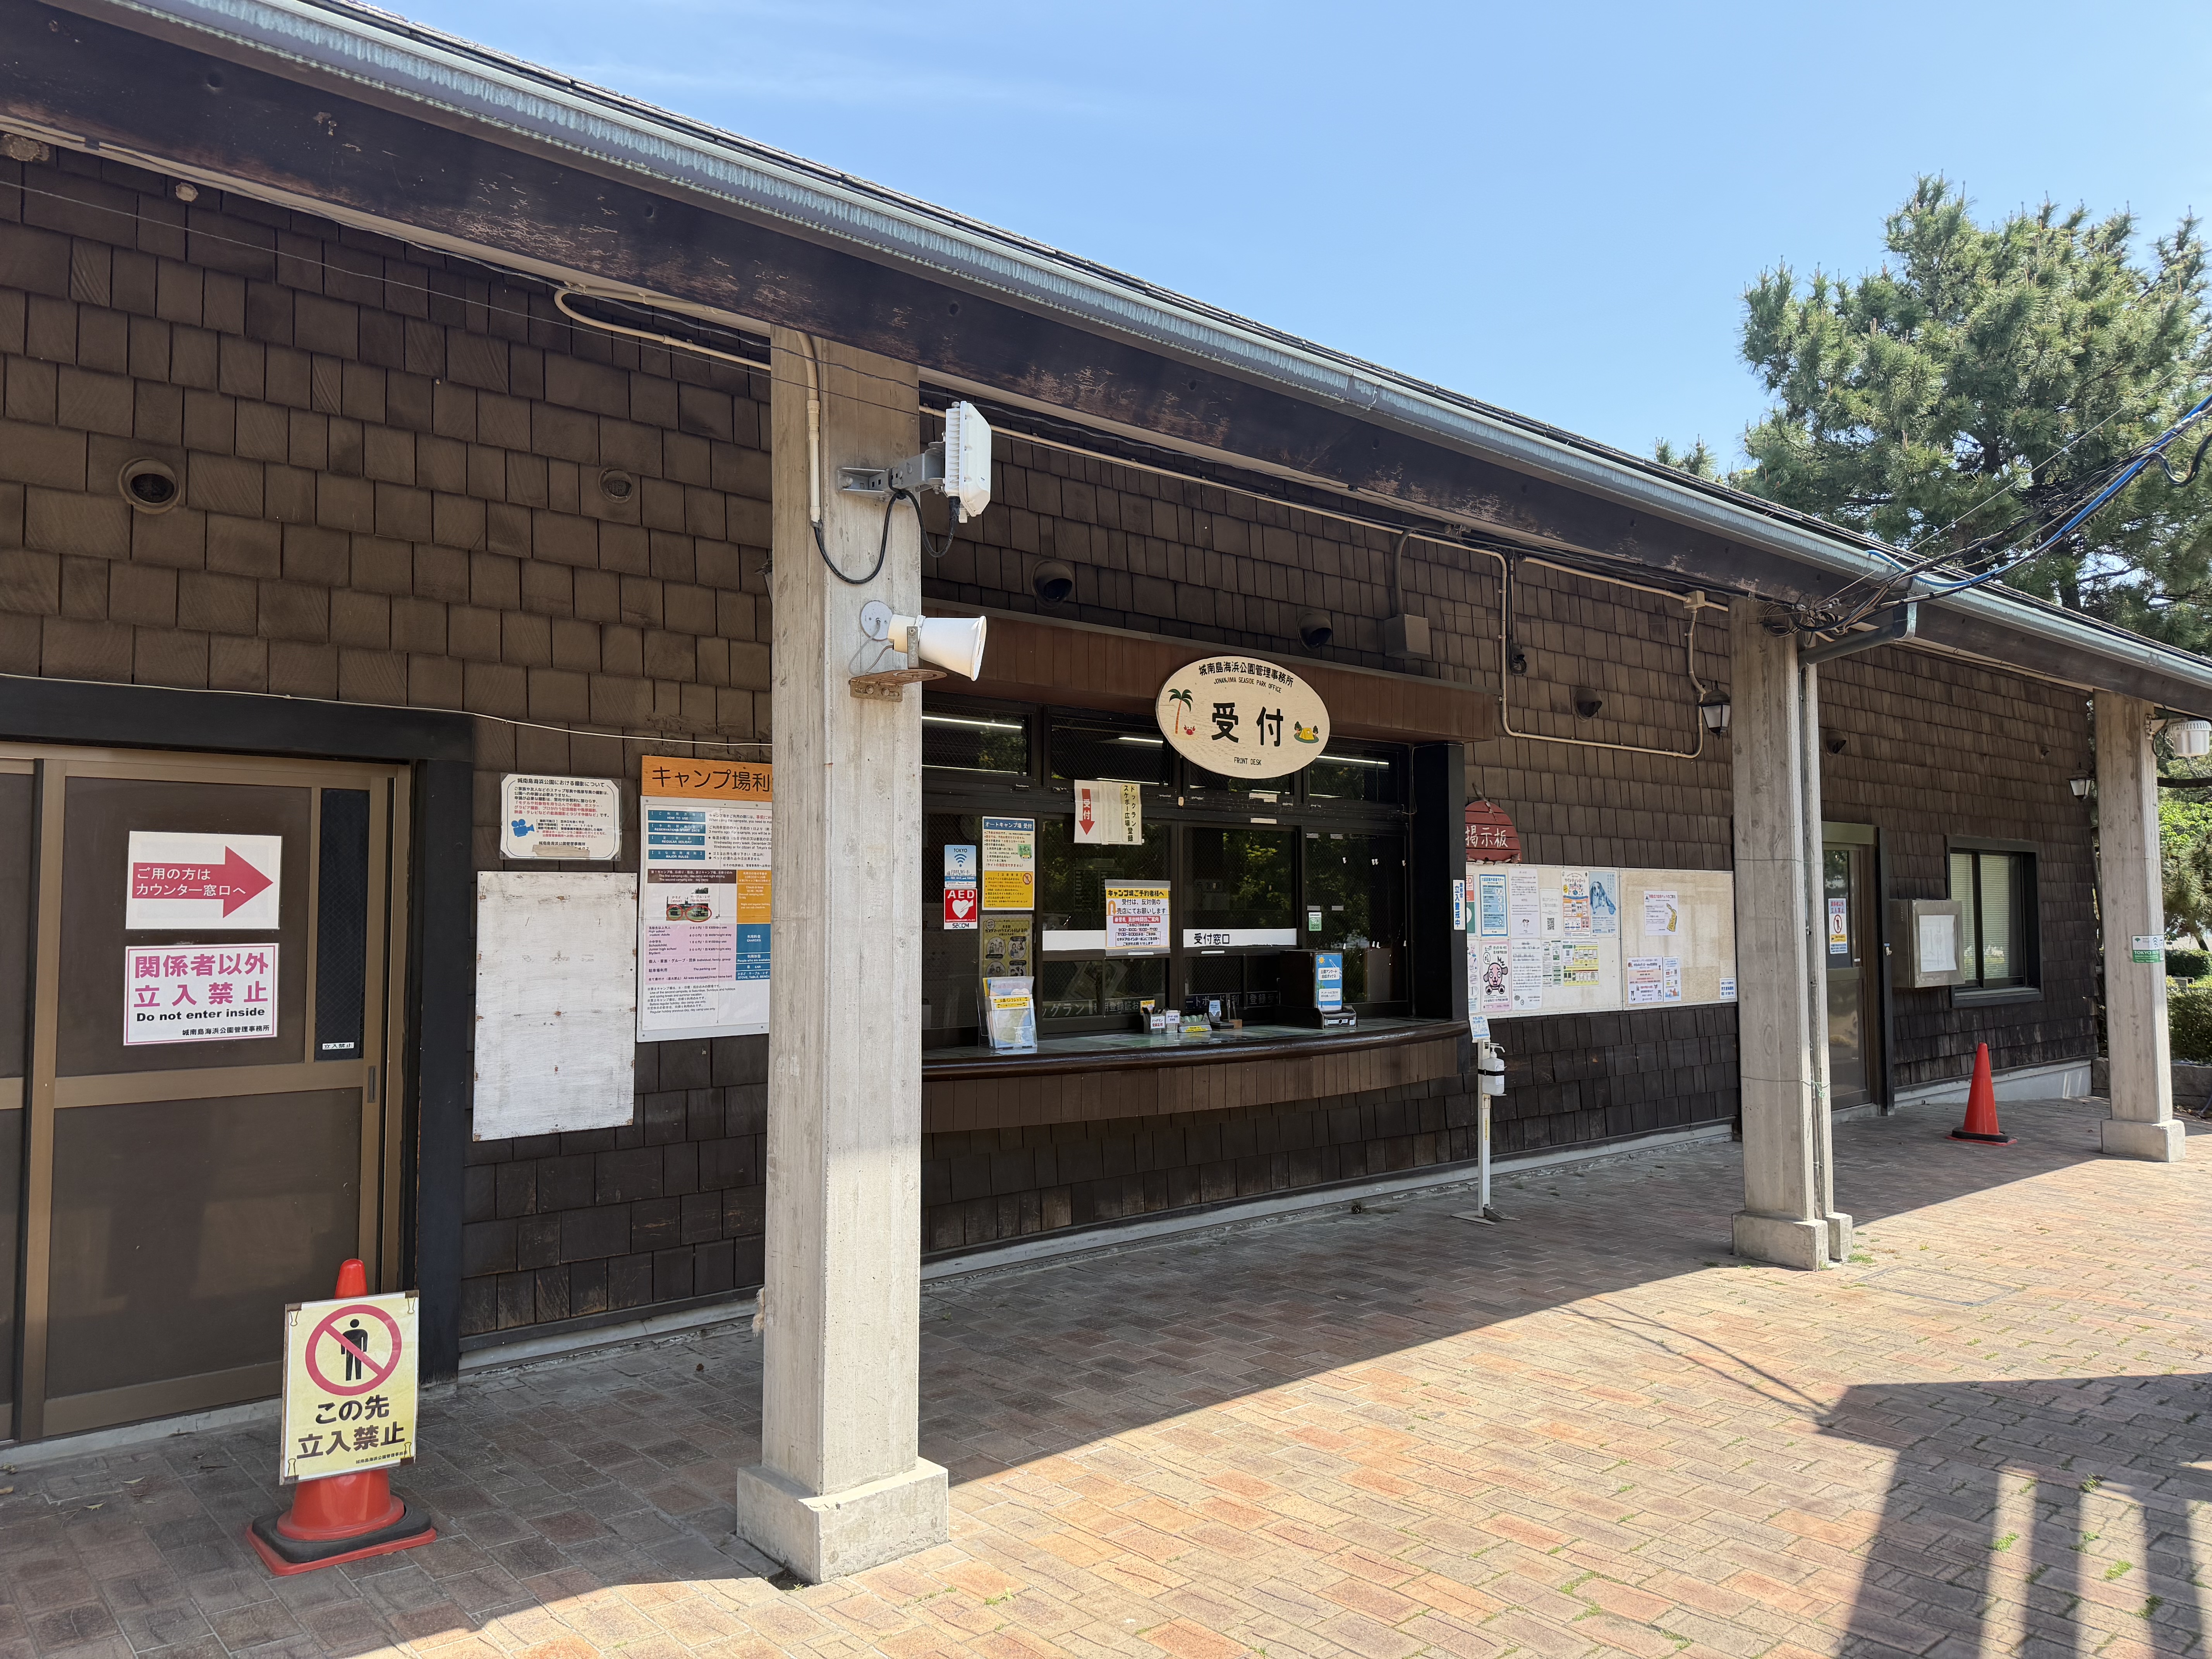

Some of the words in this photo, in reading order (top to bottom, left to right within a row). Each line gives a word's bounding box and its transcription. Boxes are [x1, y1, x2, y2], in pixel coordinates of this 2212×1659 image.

[1199, 661, 1293, 687] 城南島海浜公園管理事務所
[1238, 677, 1254, 685] SEASIDE
[1256, 679, 1266, 687] PARK
[1268, 683, 1281, 693] OFFICE
[1211, 702, 1284, 747] 受付
[652, 766, 770, 792] キャンプ場利
[1083, 799, 1091, 820] 受付
[1127, 827, 1133, 842] 登録
[1465, 825, 1508, 848] 掲示板
[137, 867, 211, 880] ご用の方は
[136, 884, 246, 896] カウンター窓口へ
[947, 890, 975, 899] AED
[1194, 933, 1230, 945] 受付窓口
[135, 952, 269, 979] 関係者以外
[134, 981, 268, 1008] 立入禁止
[137, 1013, 155, 1022] Do
[160, 1012, 184, 1021] not
[186, 1010, 222, 1019] enter
[226, 1008, 265, 1018] inside
[182, 1025, 270, 1036] 城南島海浜公園管理事務所
[315, 1394, 390, 1424] この先
[297, 1421, 405, 1459] 立入禁止
